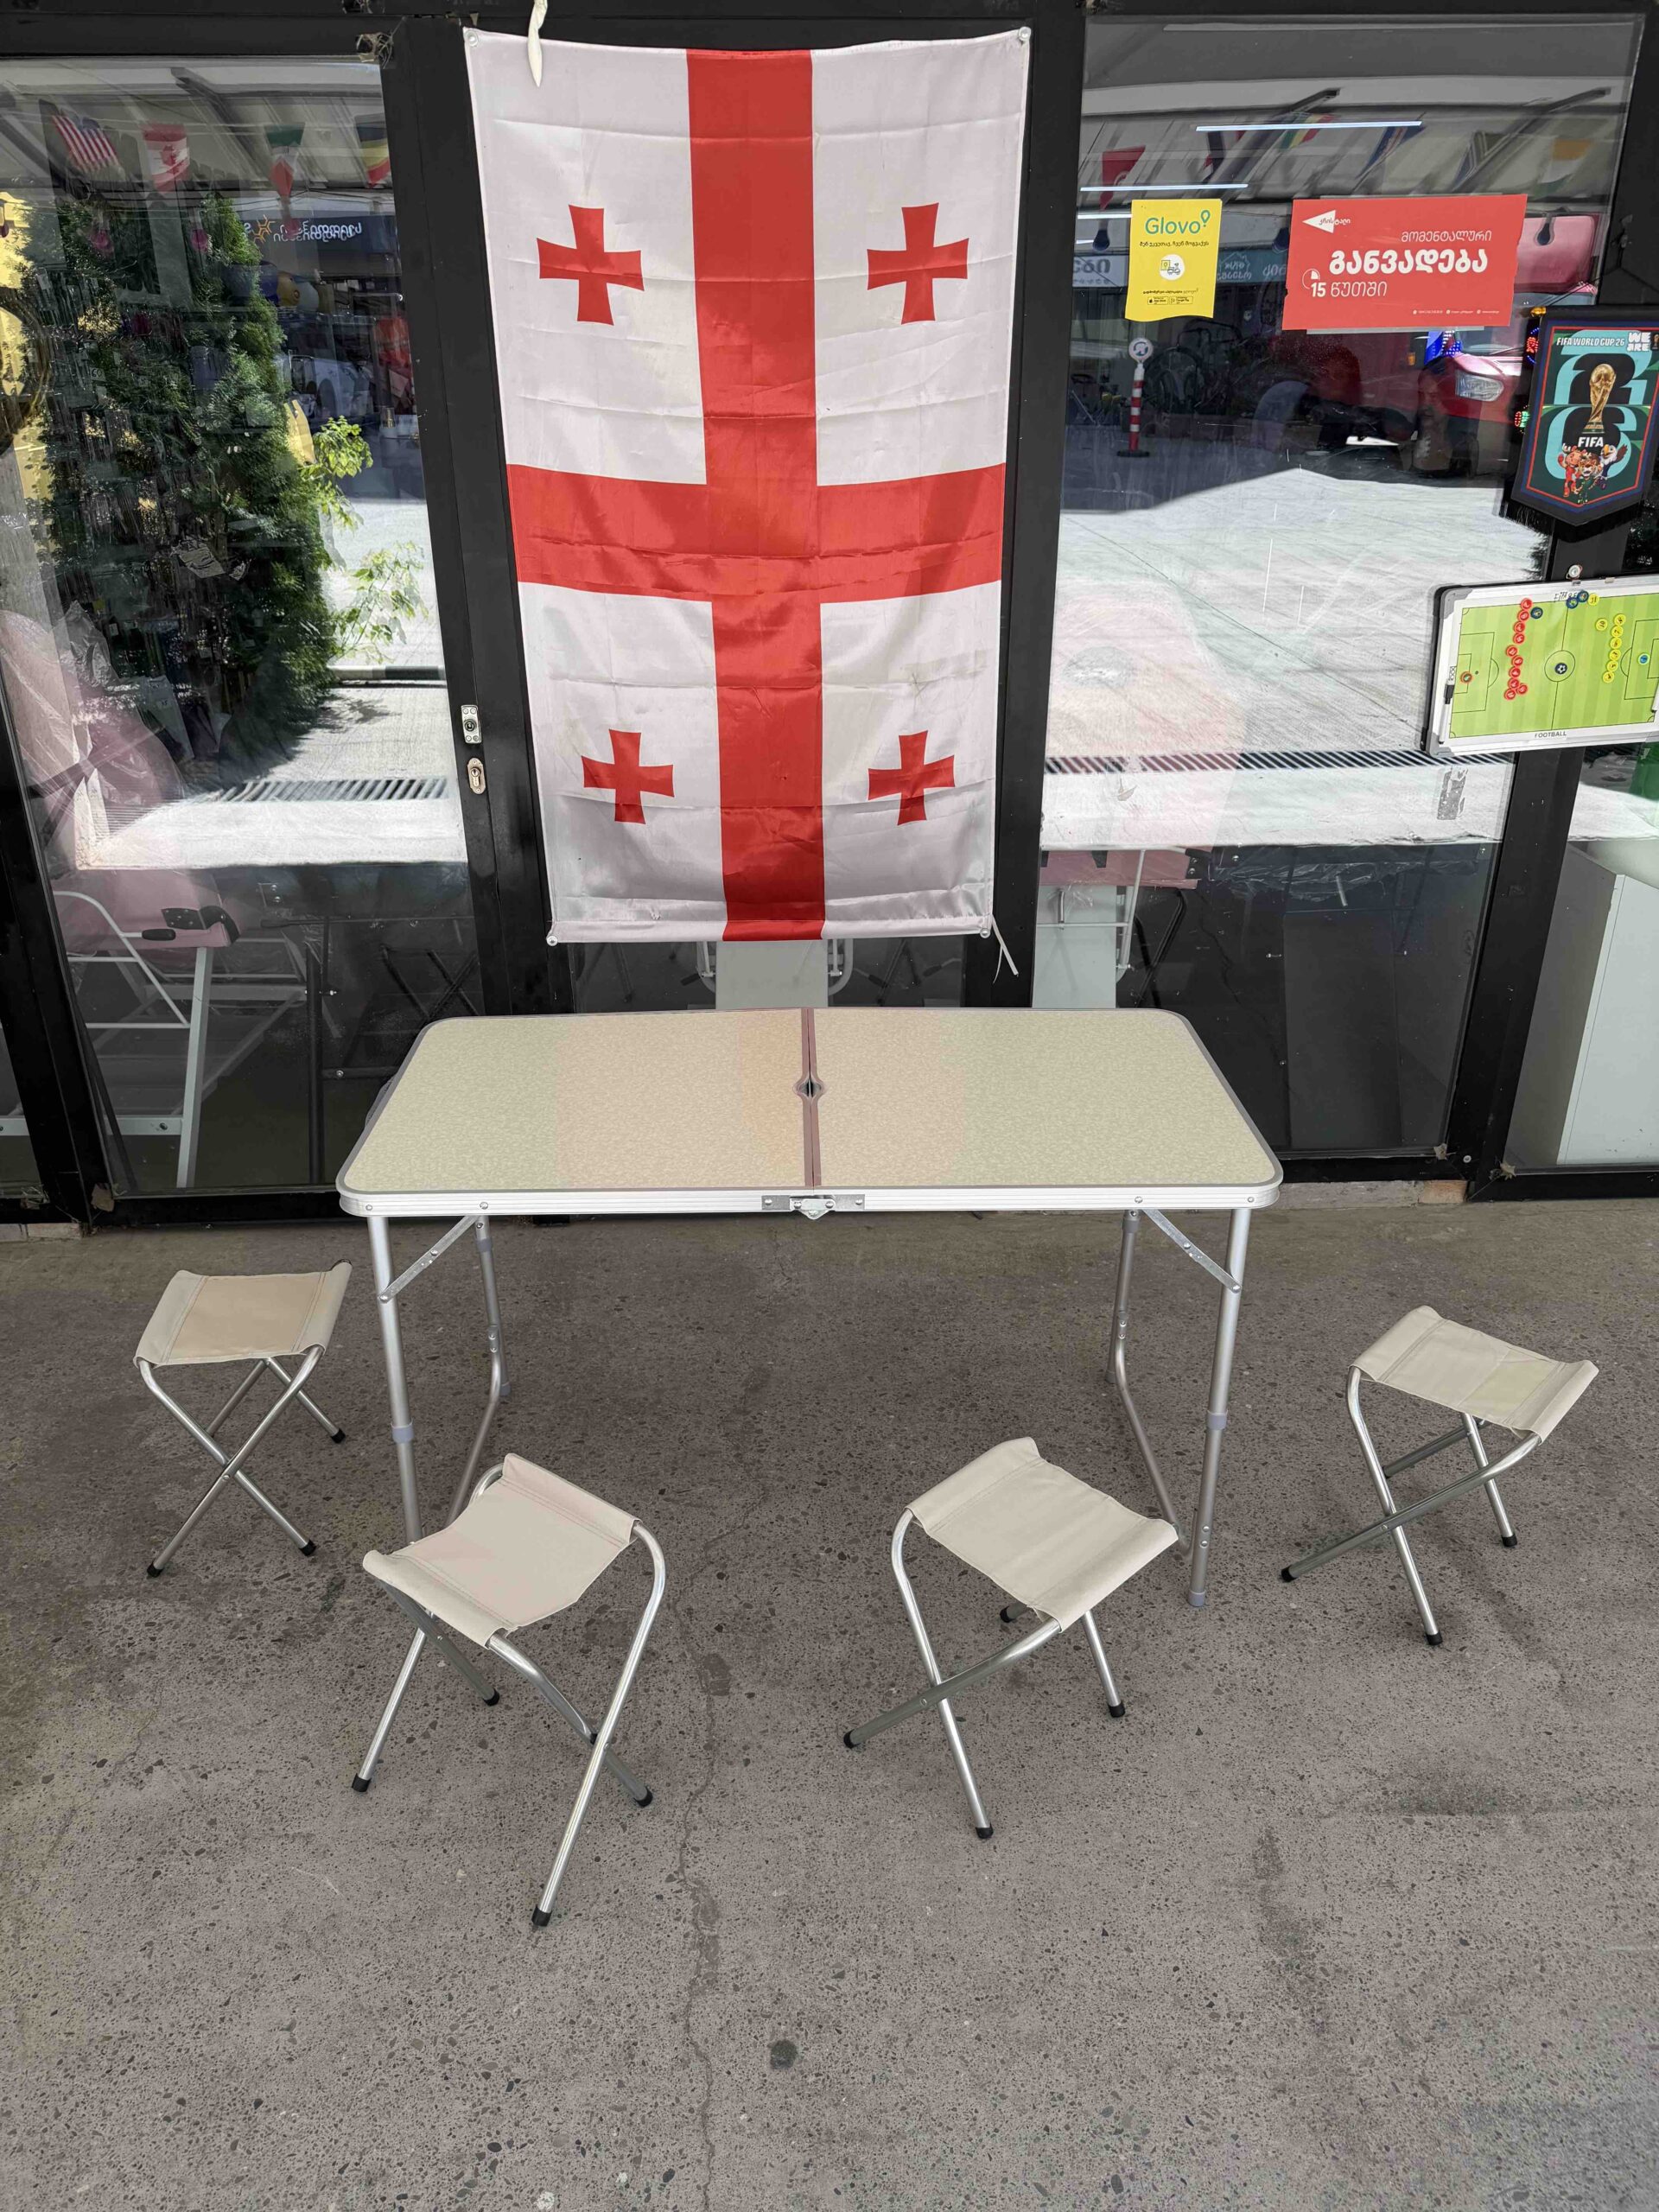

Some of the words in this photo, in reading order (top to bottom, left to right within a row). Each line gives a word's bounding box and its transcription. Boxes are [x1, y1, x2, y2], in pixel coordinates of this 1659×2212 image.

[1145, 217, 1200, 234] Glovo
[1401, 230, 1492, 242] მომენტალური
[1329, 249, 1488, 275] განვადება
[1311, 282, 1326, 297] 15
[1331, 281, 1388, 297] წუთში
[1556, 337, 1572, 346] FIFA
[1573, 337, 1599, 346] WORLD
[1600, 338, 1614, 346] CUP
[1615, 338, 1625, 346] 26
[1628, 332, 1651, 343] WE
[1578, 436, 1604, 448] FIFA
